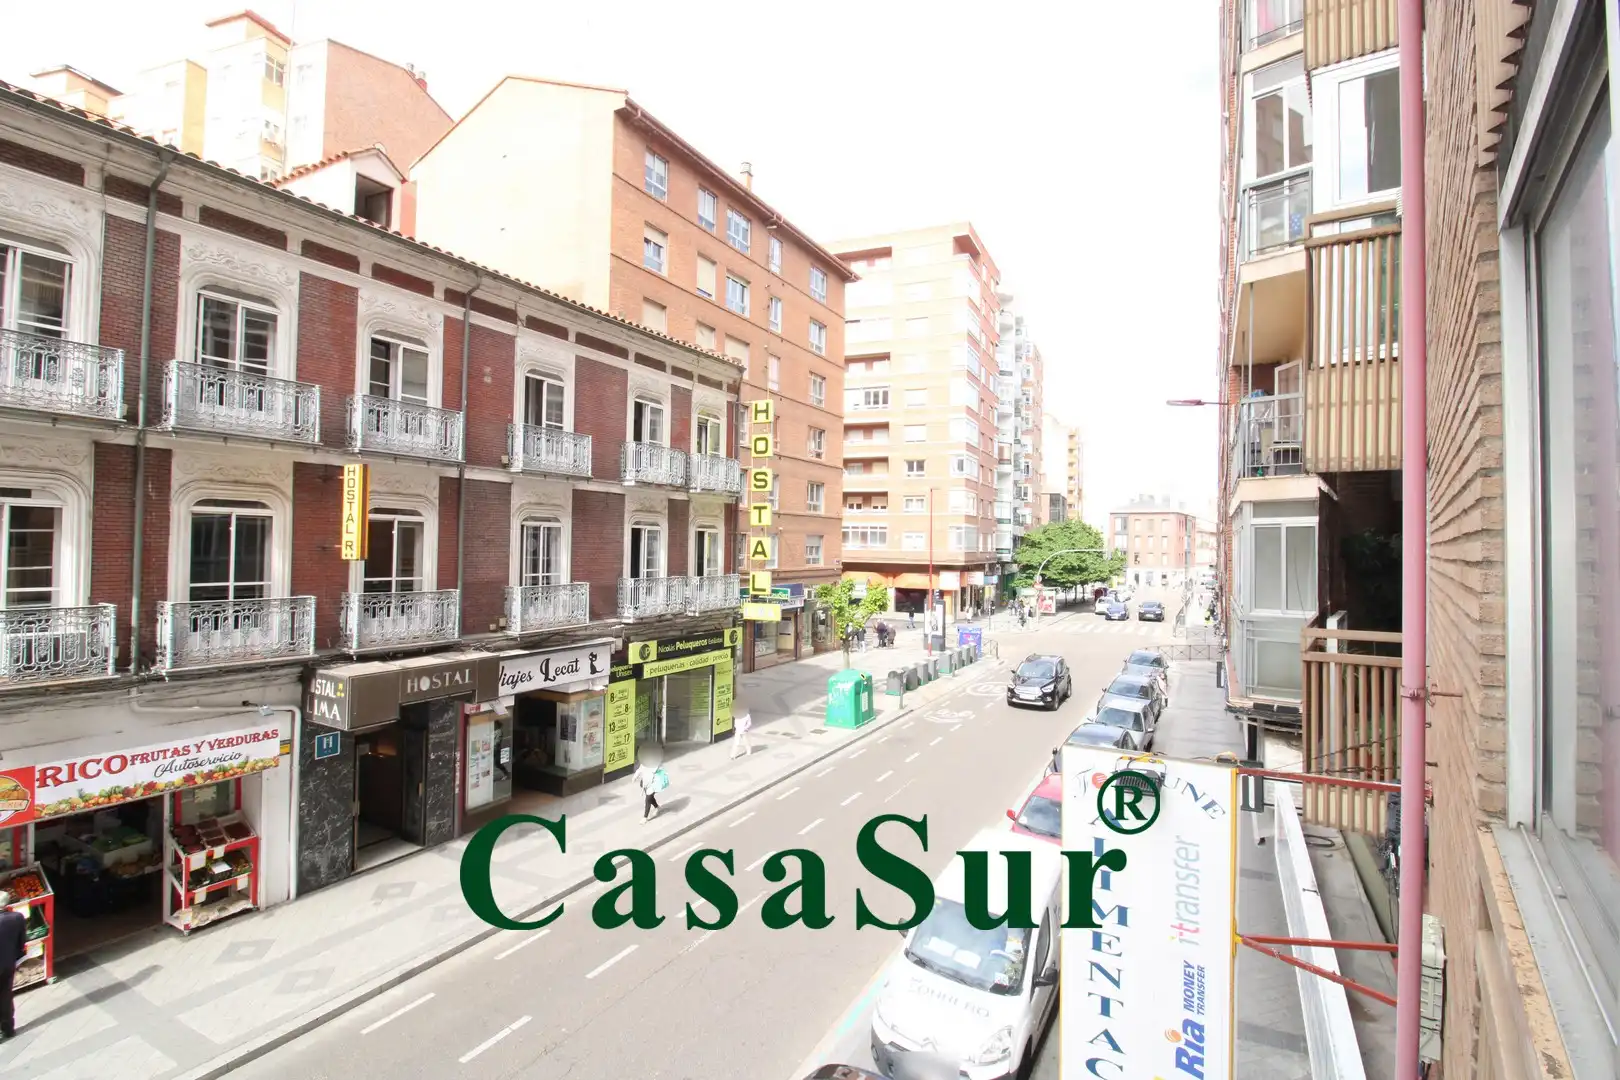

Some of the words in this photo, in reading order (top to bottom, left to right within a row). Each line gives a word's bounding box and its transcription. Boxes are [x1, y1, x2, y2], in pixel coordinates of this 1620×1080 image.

[345, 467, 356, 535] HOSTAL
[752, 402, 769, 592] HOSTAL
[345, 541, 354, 551] R
[406, 668, 474, 694] HOSTAL
[540, 657, 580, 682] Lecat
[609, 721, 616, 733] 13
[36, 754, 129, 789] RICO
[129, 744, 191, 766] FRUTAS
[193, 739, 206, 753] Y
[207, 729, 279, 751] VERDURAS
[153, 752, 243, 778] Autoservicio
[1168, 834, 1200, 946] itransfer
[1183, 959, 1196, 1013] MONEY
[1196, 964, 1206, 1016] TRANSFER
[1165, 1018, 1205, 1080] Ria
